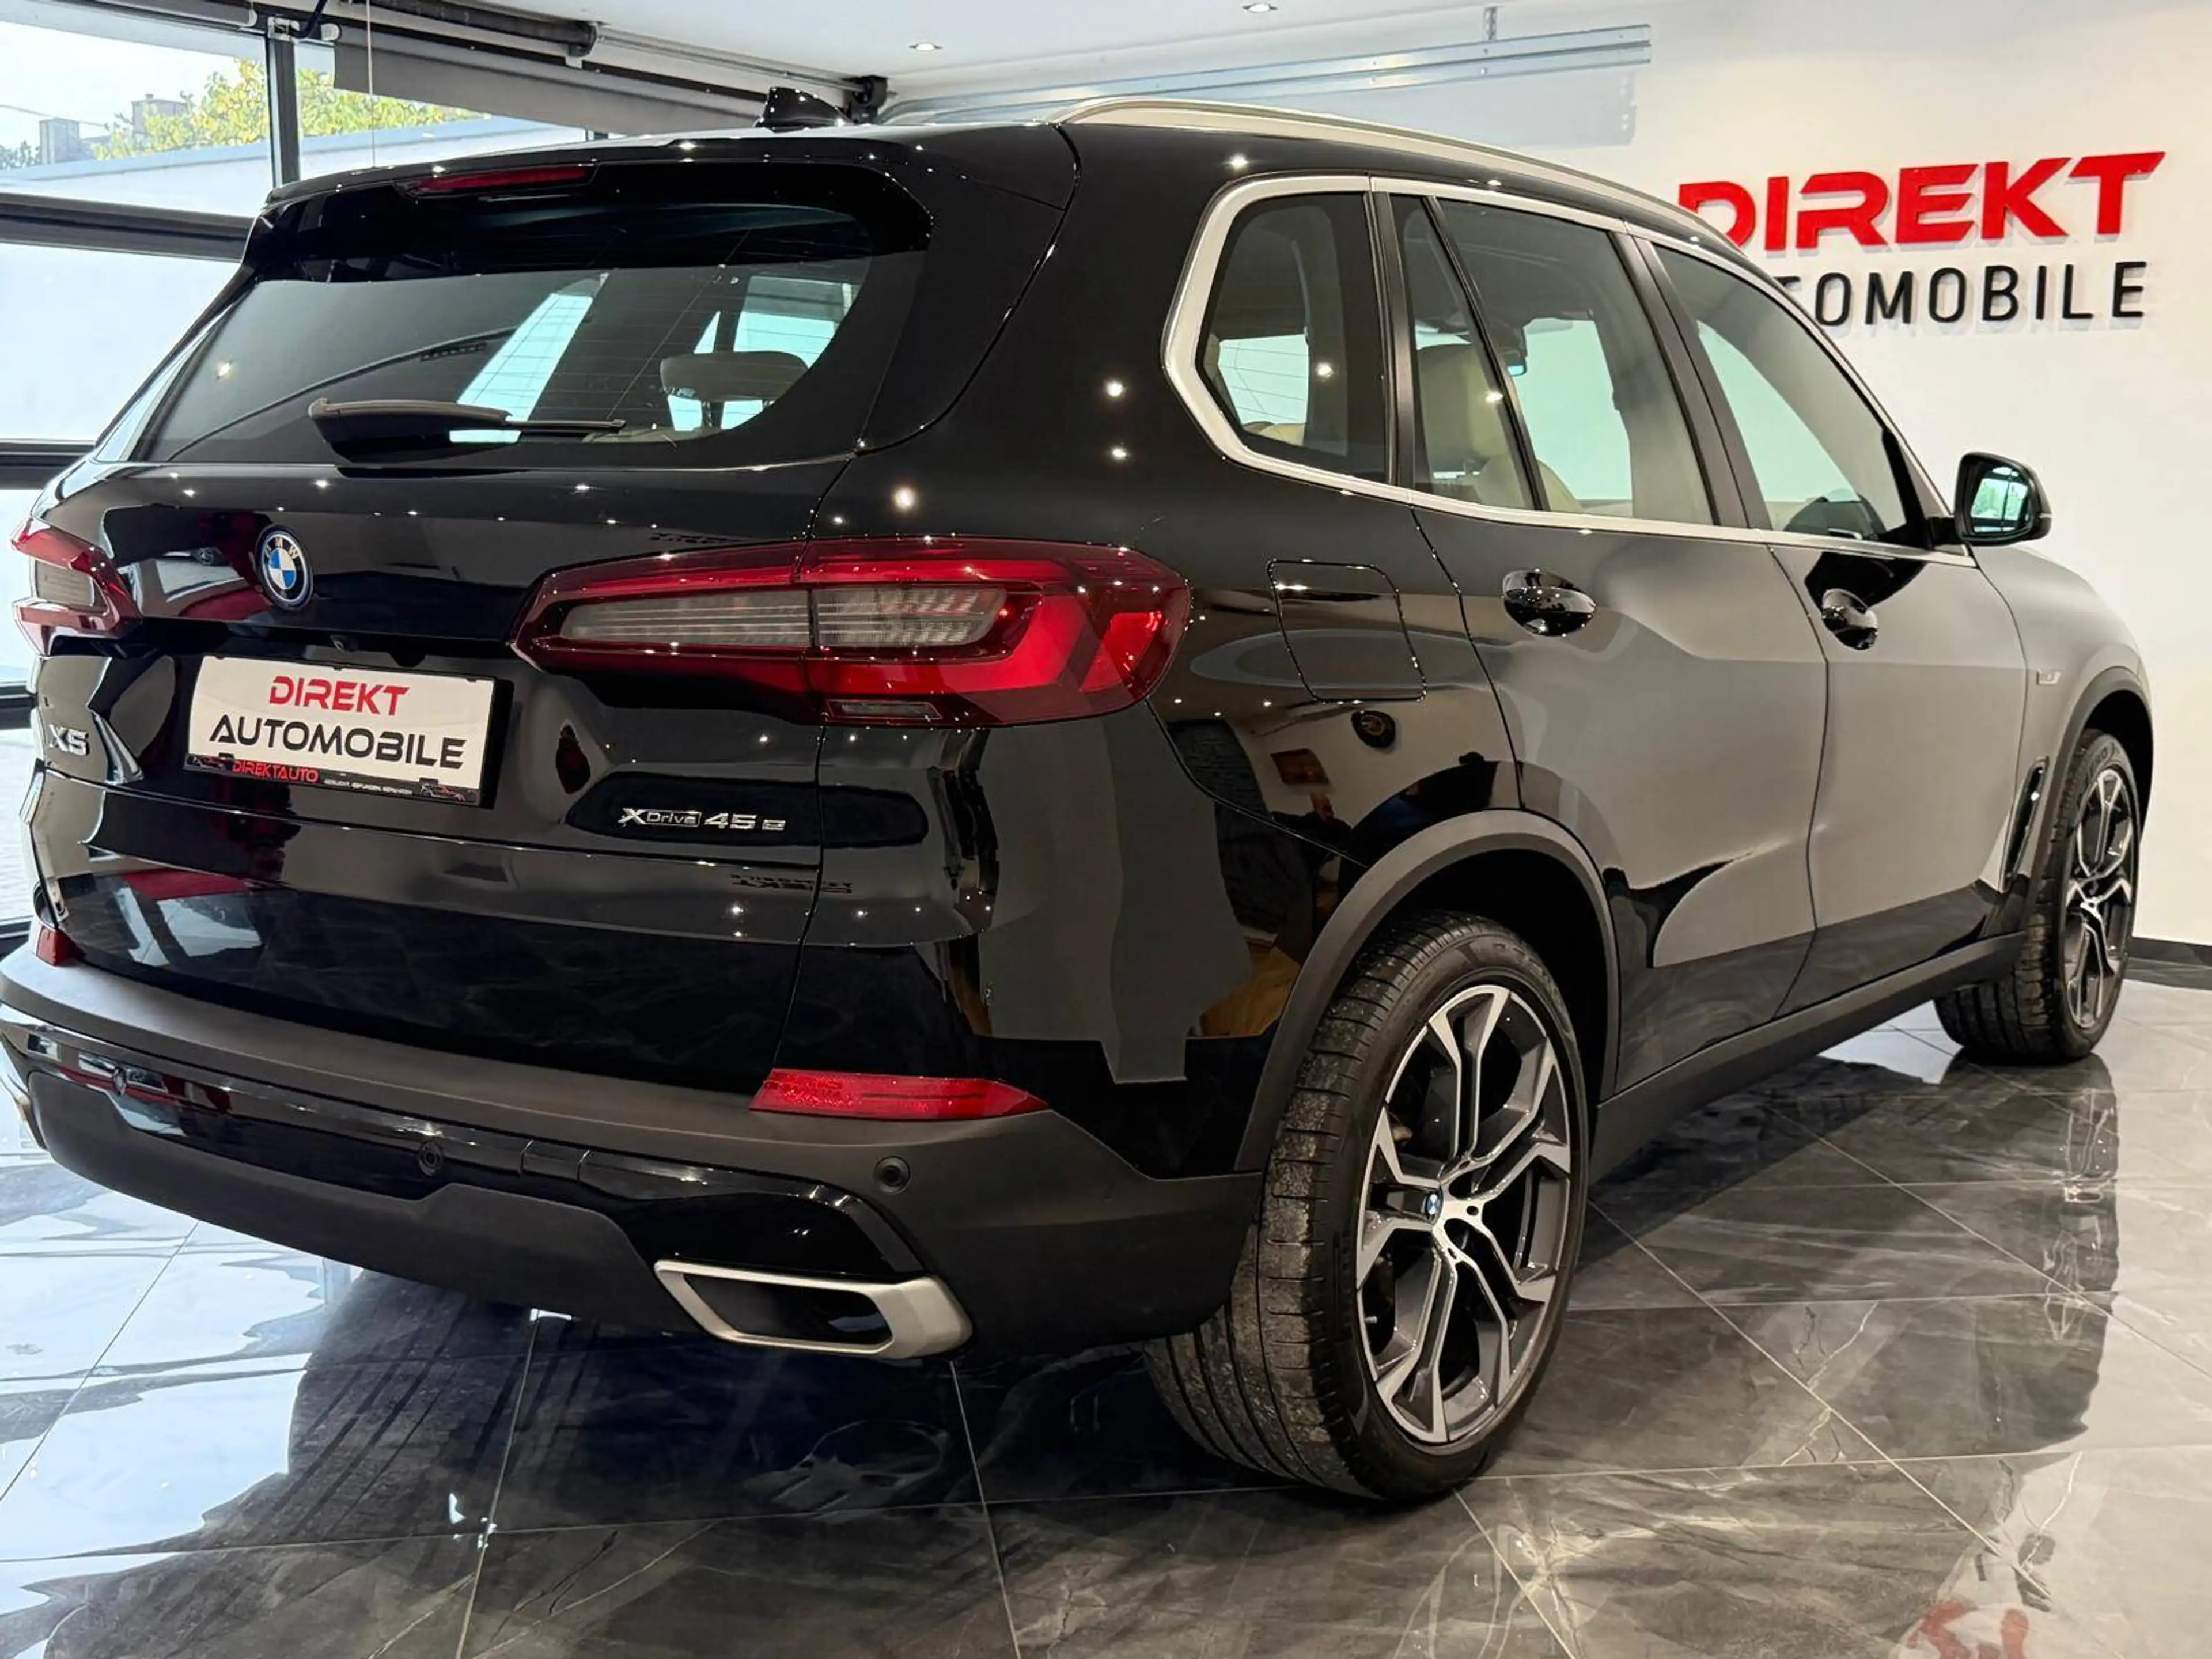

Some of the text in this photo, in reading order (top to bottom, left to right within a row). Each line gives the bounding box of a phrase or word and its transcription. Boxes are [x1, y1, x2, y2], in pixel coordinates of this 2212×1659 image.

[1678, 152, 2166, 251] DIREKT
[270, 676, 410, 715] DIREKT
[49, 724, 89, 756] X5
[209, 714, 467, 769] AUTOMOBILE
[232, 760, 319, 782] DIREKTAUTO
